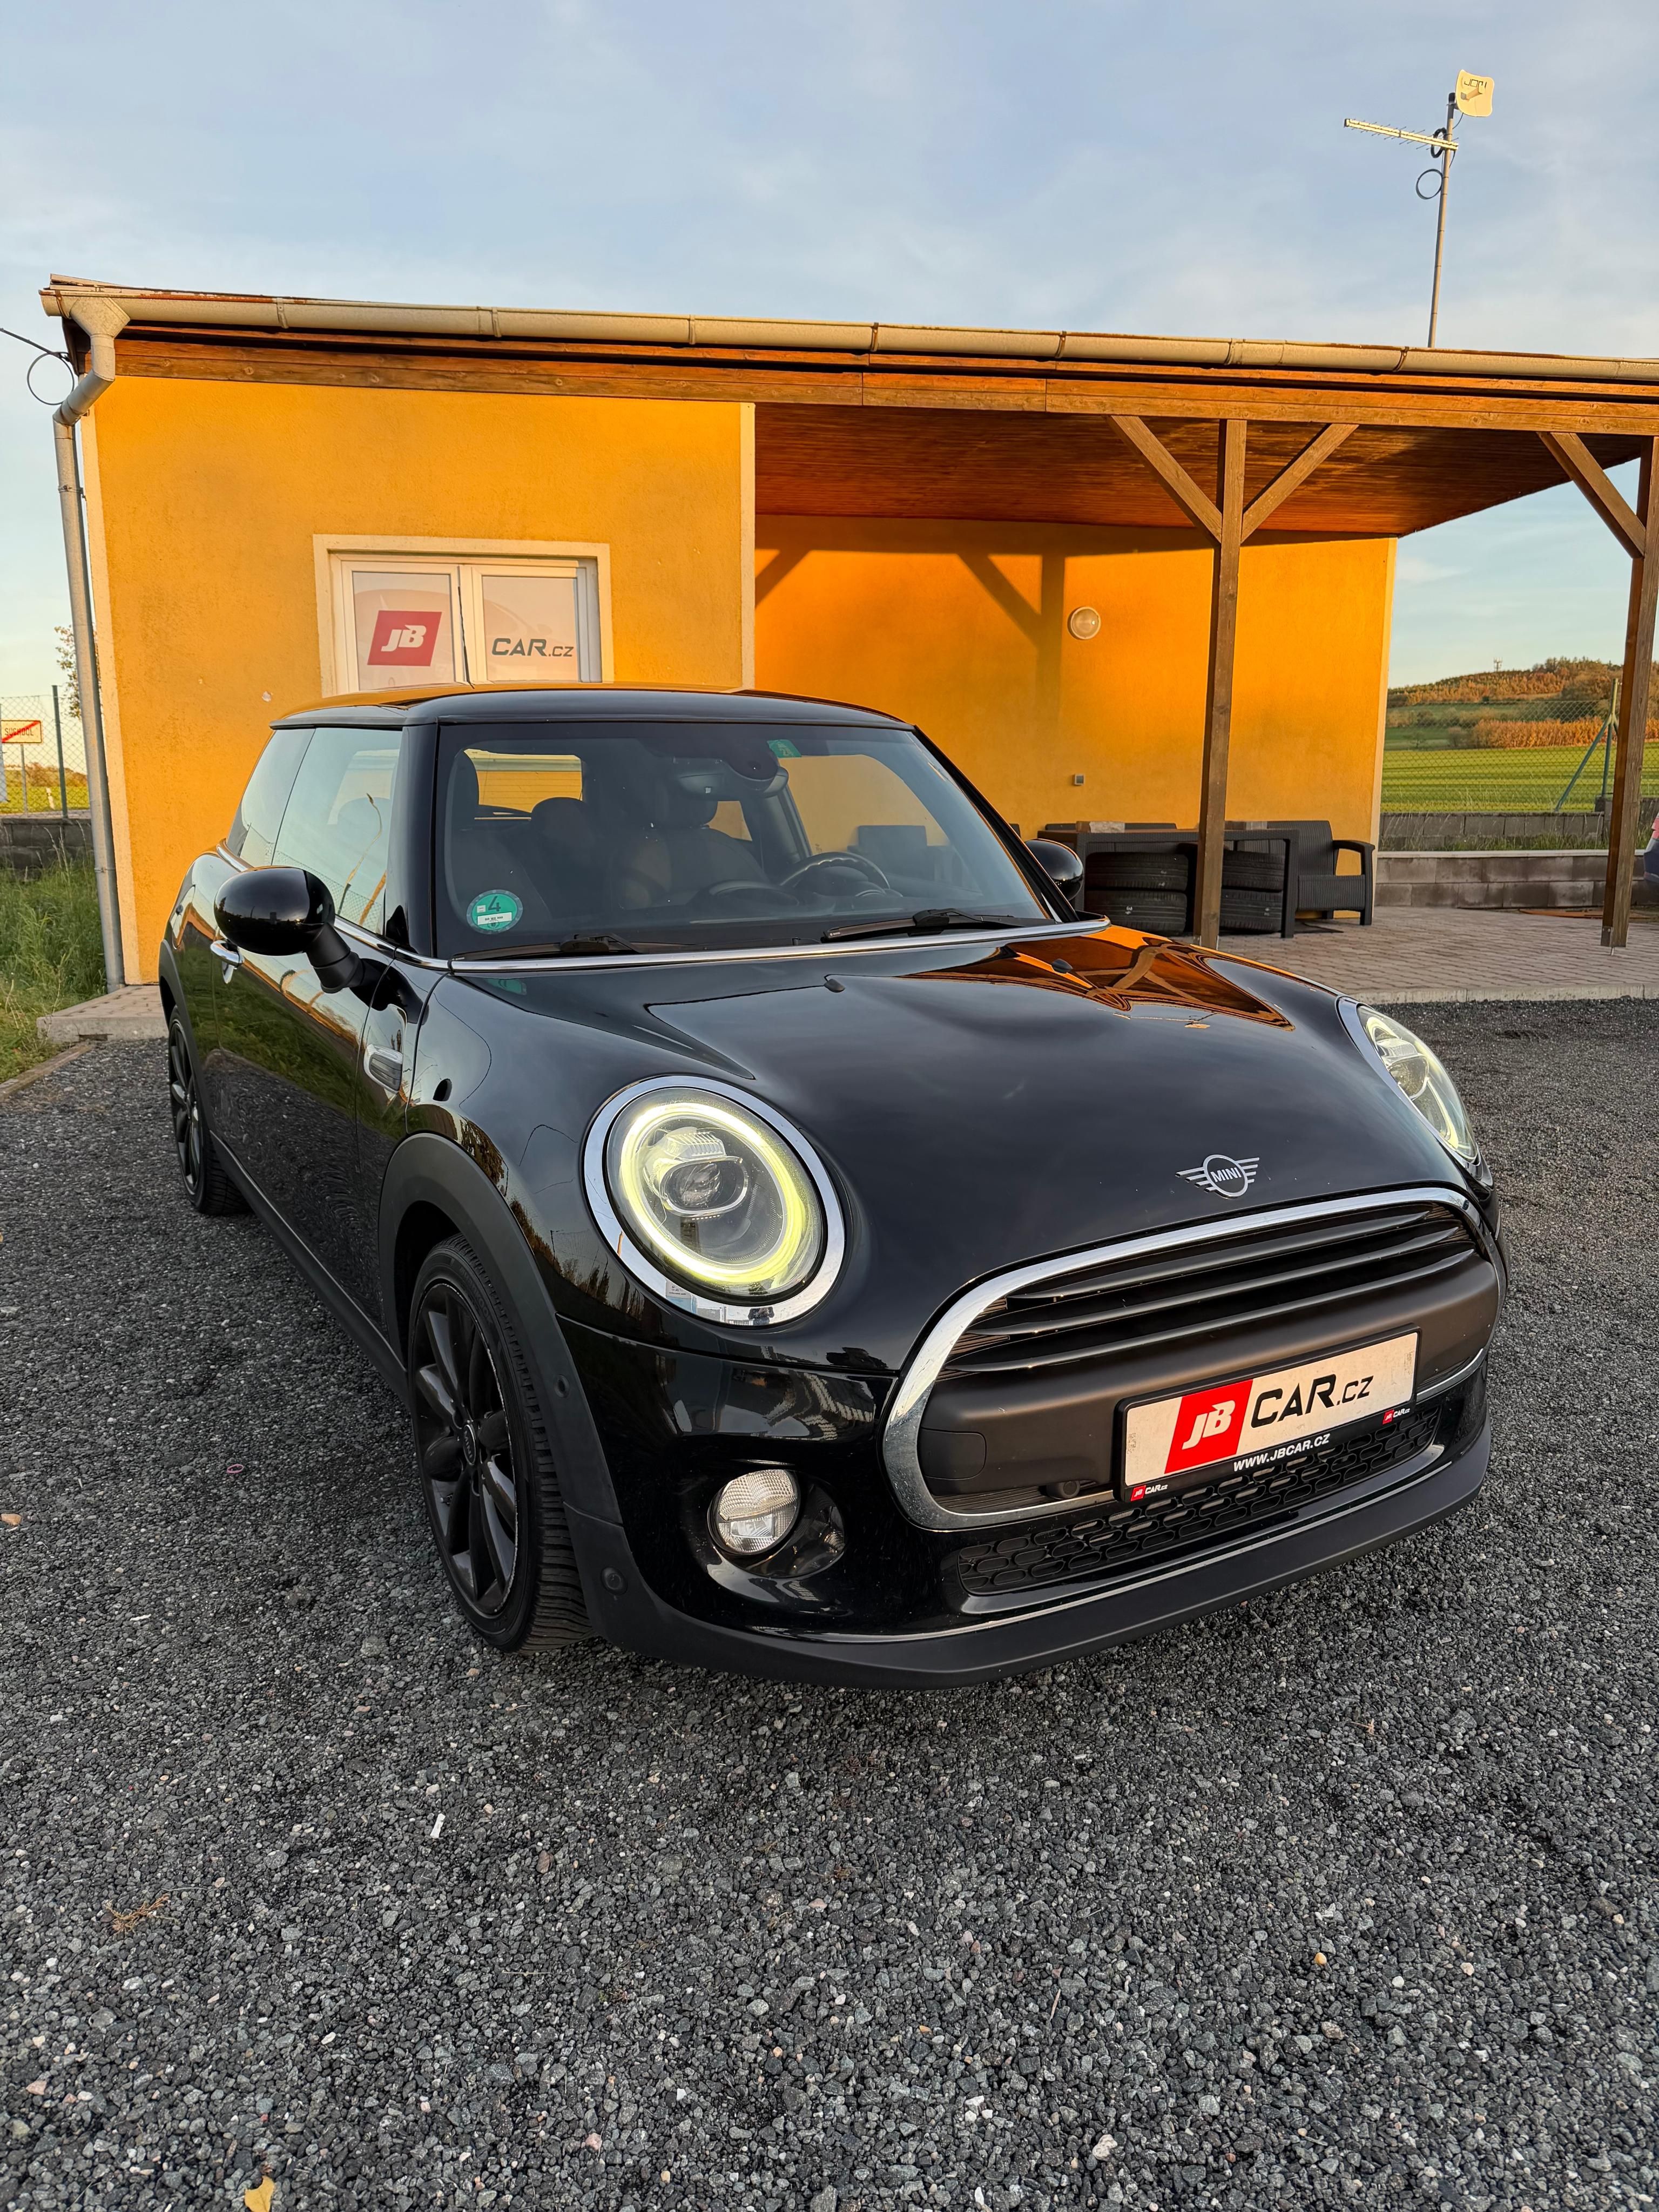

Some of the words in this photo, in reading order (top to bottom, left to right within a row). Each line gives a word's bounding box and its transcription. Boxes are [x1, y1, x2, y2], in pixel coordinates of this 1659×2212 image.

[381, 625, 427, 652] JB
[488, 895, 501, 912] 4
[1210, 1167, 1242, 1182] MINI
[1182, 1400, 1236, 1450] JB
[1233, 1433, 1330, 1472] WWW.JBCAR.CZ
